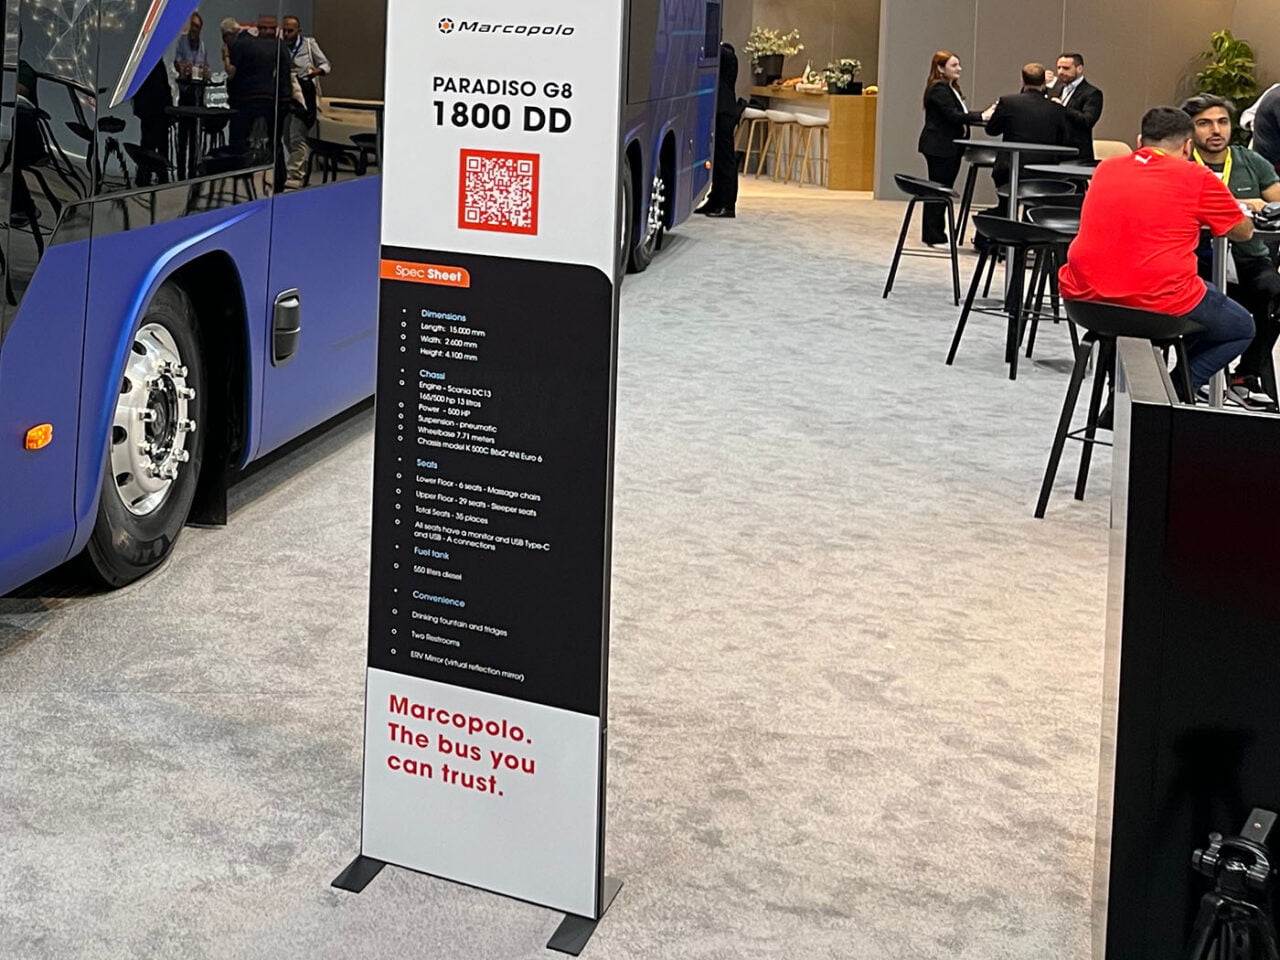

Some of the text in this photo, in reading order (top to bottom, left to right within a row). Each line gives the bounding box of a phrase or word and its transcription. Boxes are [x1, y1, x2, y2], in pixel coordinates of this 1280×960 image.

[458, 21, 575, 36] Marcopolo
[433, 76, 573, 99] PARADISO G8
[433, 100, 571, 133] 1800 DD
[395, 264, 462, 282] Spec Sheet
[421, 309, 467, 322] Dimensions
[420, 322, 446, 333] Length:
[471, 329, 486, 337] mm
[463, 341, 478, 349] mm
[463, 353, 478, 361] mm
[418, 381, 442, 392] Engine
[447, 385, 471, 395] Scania
[472, 388, 492, 398] DC13
[418, 403, 440, 413] Power
[460, 409, 471, 417] HP
[446, 396, 456, 405] hp
[457, 398, 465, 406] 13
[417, 414, 455, 426] Suspension
[459, 421, 498, 433] pneumatic
[417, 425, 456, 438] Wheelbase
[471, 434, 495, 444] meters
[417, 437, 441, 448] Chassis
[465, 444, 471, 452] K
[520, 451, 537, 462] Euro
[537, 455, 543, 463] 6
[416, 458, 438, 469] Seats
[416, 474, 436, 485] Lower
[437, 478, 454, 488] Floor
[458, 482, 464, 490] 6
[464, 483, 483, 493] seats
[487, 486, 519, 499] Massage
[519, 491, 542, 502] chairs
[415, 490, 436, 501] Upper
[437, 494, 454, 503] Floor
[458, 497, 467, 506] 29
[468, 500, 486, 509] seats
[490, 502, 518, 514] Sleeper
[518, 507, 538, 517] seats
[415, 505, 431, 515] Total
[431, 508, 451, 518] Seats
[464, 514, 489, 525] places
[413, 529, 428, 539] and
[428, 532, 442, 542] USB
[446, 536, 453, 544] A
[453, 538, 496, 551] connections
[414, 520, 424, 530] All
[424, 522, 442, 532] seats
[442, 525, 461, 535] have
[467, 531, 494, 542] monitor
[495, 534, 510, 544] and
[510, 537, 524, 547] USB
[524, 540, 551, 552] Type-C
[413, 546, 450, 560] Fuel tank
[412, 590, 466, 608] Convenience
[411, 610, 508, 637] Drinking fountain and fridges
[411, 630, 461, 647] Two Restrooms
[424, 653, 444, 664] Mirror
[444, 657, 468, 670] (virtual
[468, 663, 501, 676] reflection
[501, 670, 525, 683] mirror)
[389, 694, 532, 745] Marcopolo.
[387, 722, 535, 775] The bus you
[387, 755, 504, 797] can trust.
